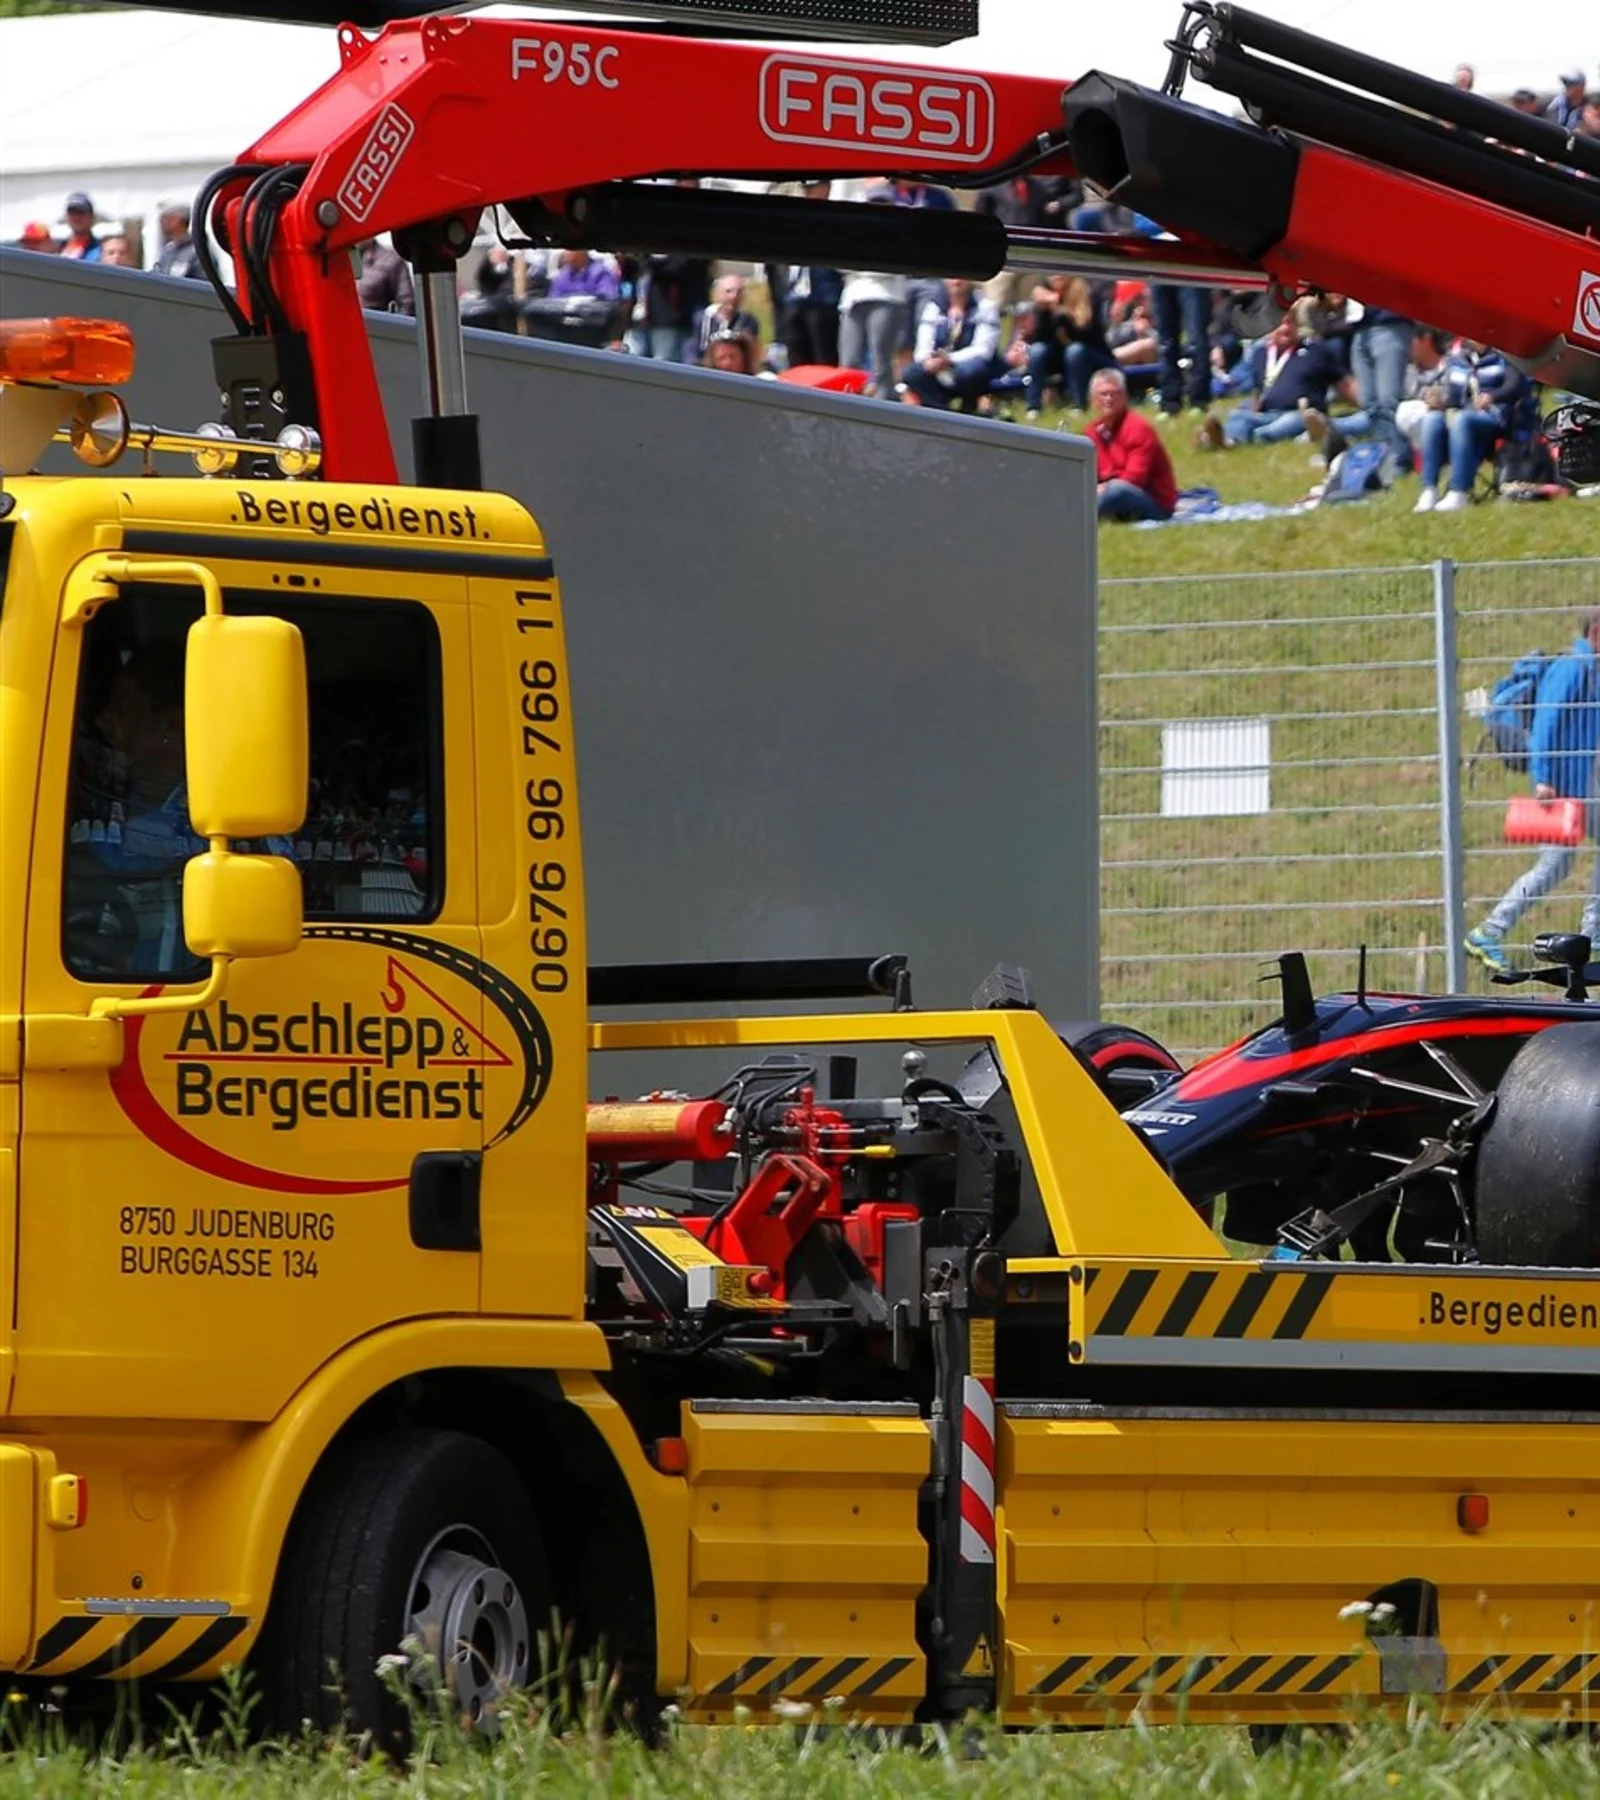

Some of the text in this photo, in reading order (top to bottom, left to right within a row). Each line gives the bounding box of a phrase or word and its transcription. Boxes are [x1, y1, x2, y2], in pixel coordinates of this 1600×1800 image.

[511, 37, 620, 89] F95C
[778, 68, 976, 149] FASSI
[345, 114, 406, 211] FASSI
[514, 589, 570, 995] 0676 96 766 11
[177, 999, 471, 1070] Abschlepp &
[176, 1062, 483, 1132] Bergedienst
[120, 1206, 335, 1241] 8750 JUDENBURG
[120, 1245, 319, 1279] BURGGASSE 134
